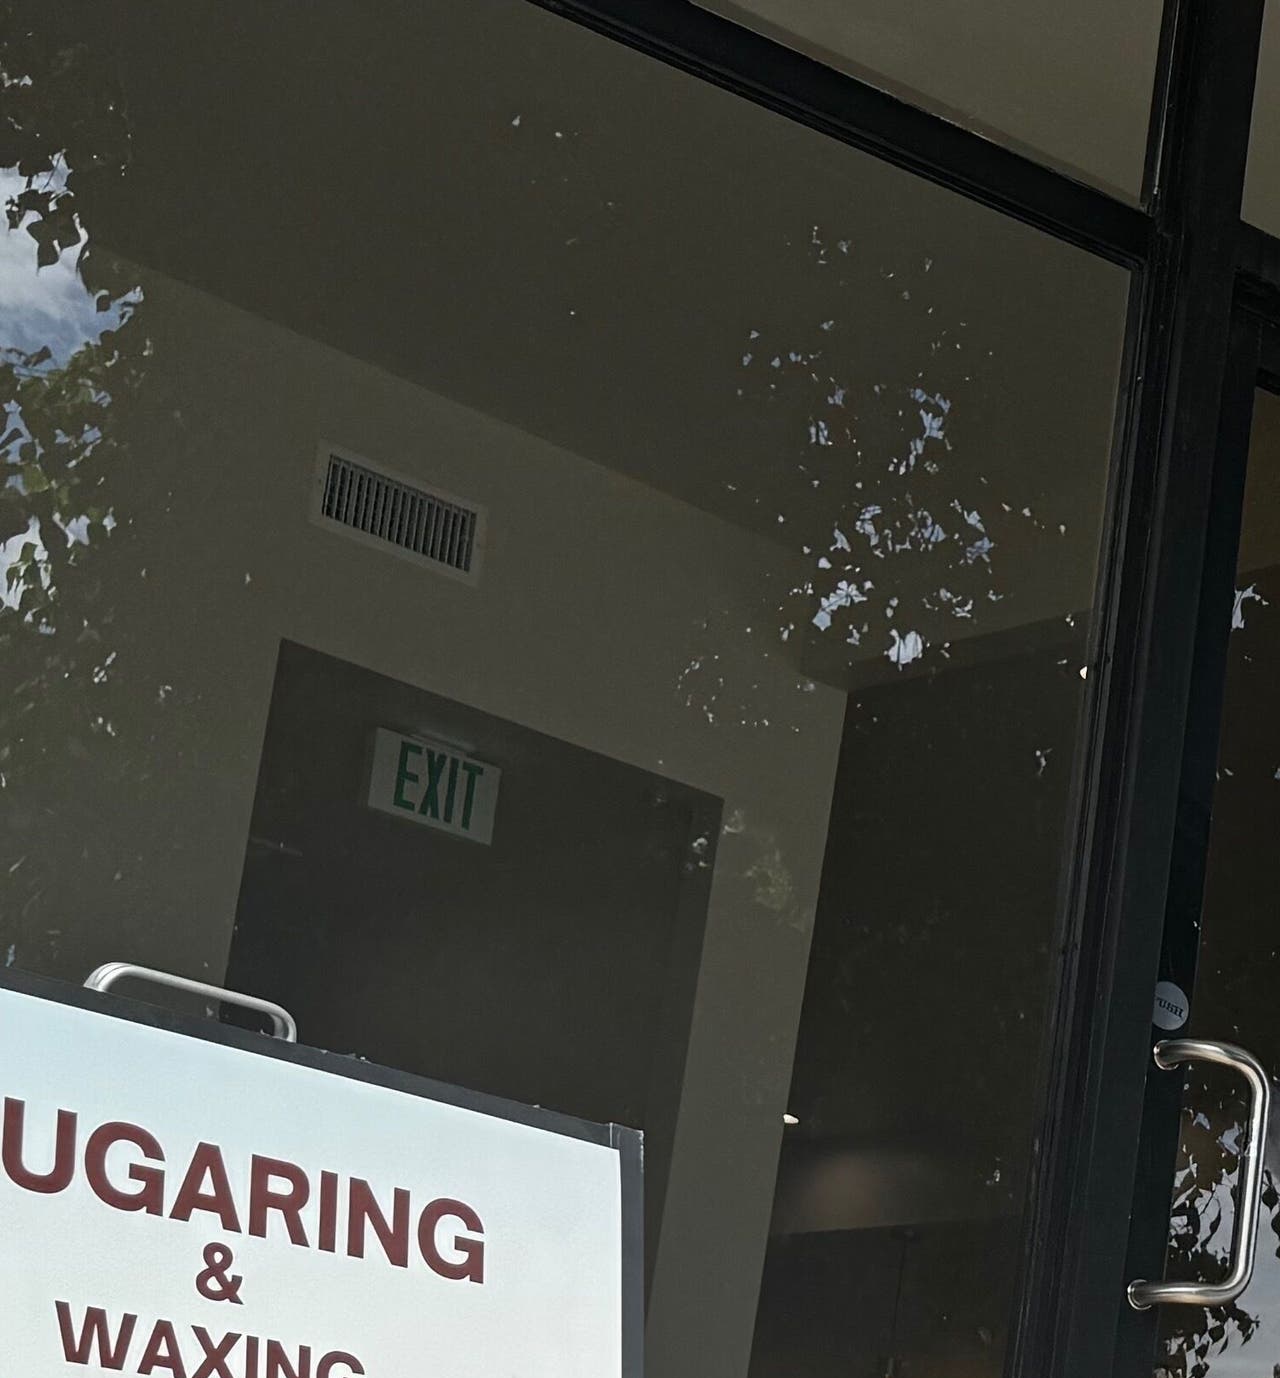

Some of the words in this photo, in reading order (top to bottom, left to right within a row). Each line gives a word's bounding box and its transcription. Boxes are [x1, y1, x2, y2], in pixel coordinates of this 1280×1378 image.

[393, 741, 484, 830] EXIT
[1157, 998, 1184, 1018] USH
[195, 1242, 243, 1305] &
